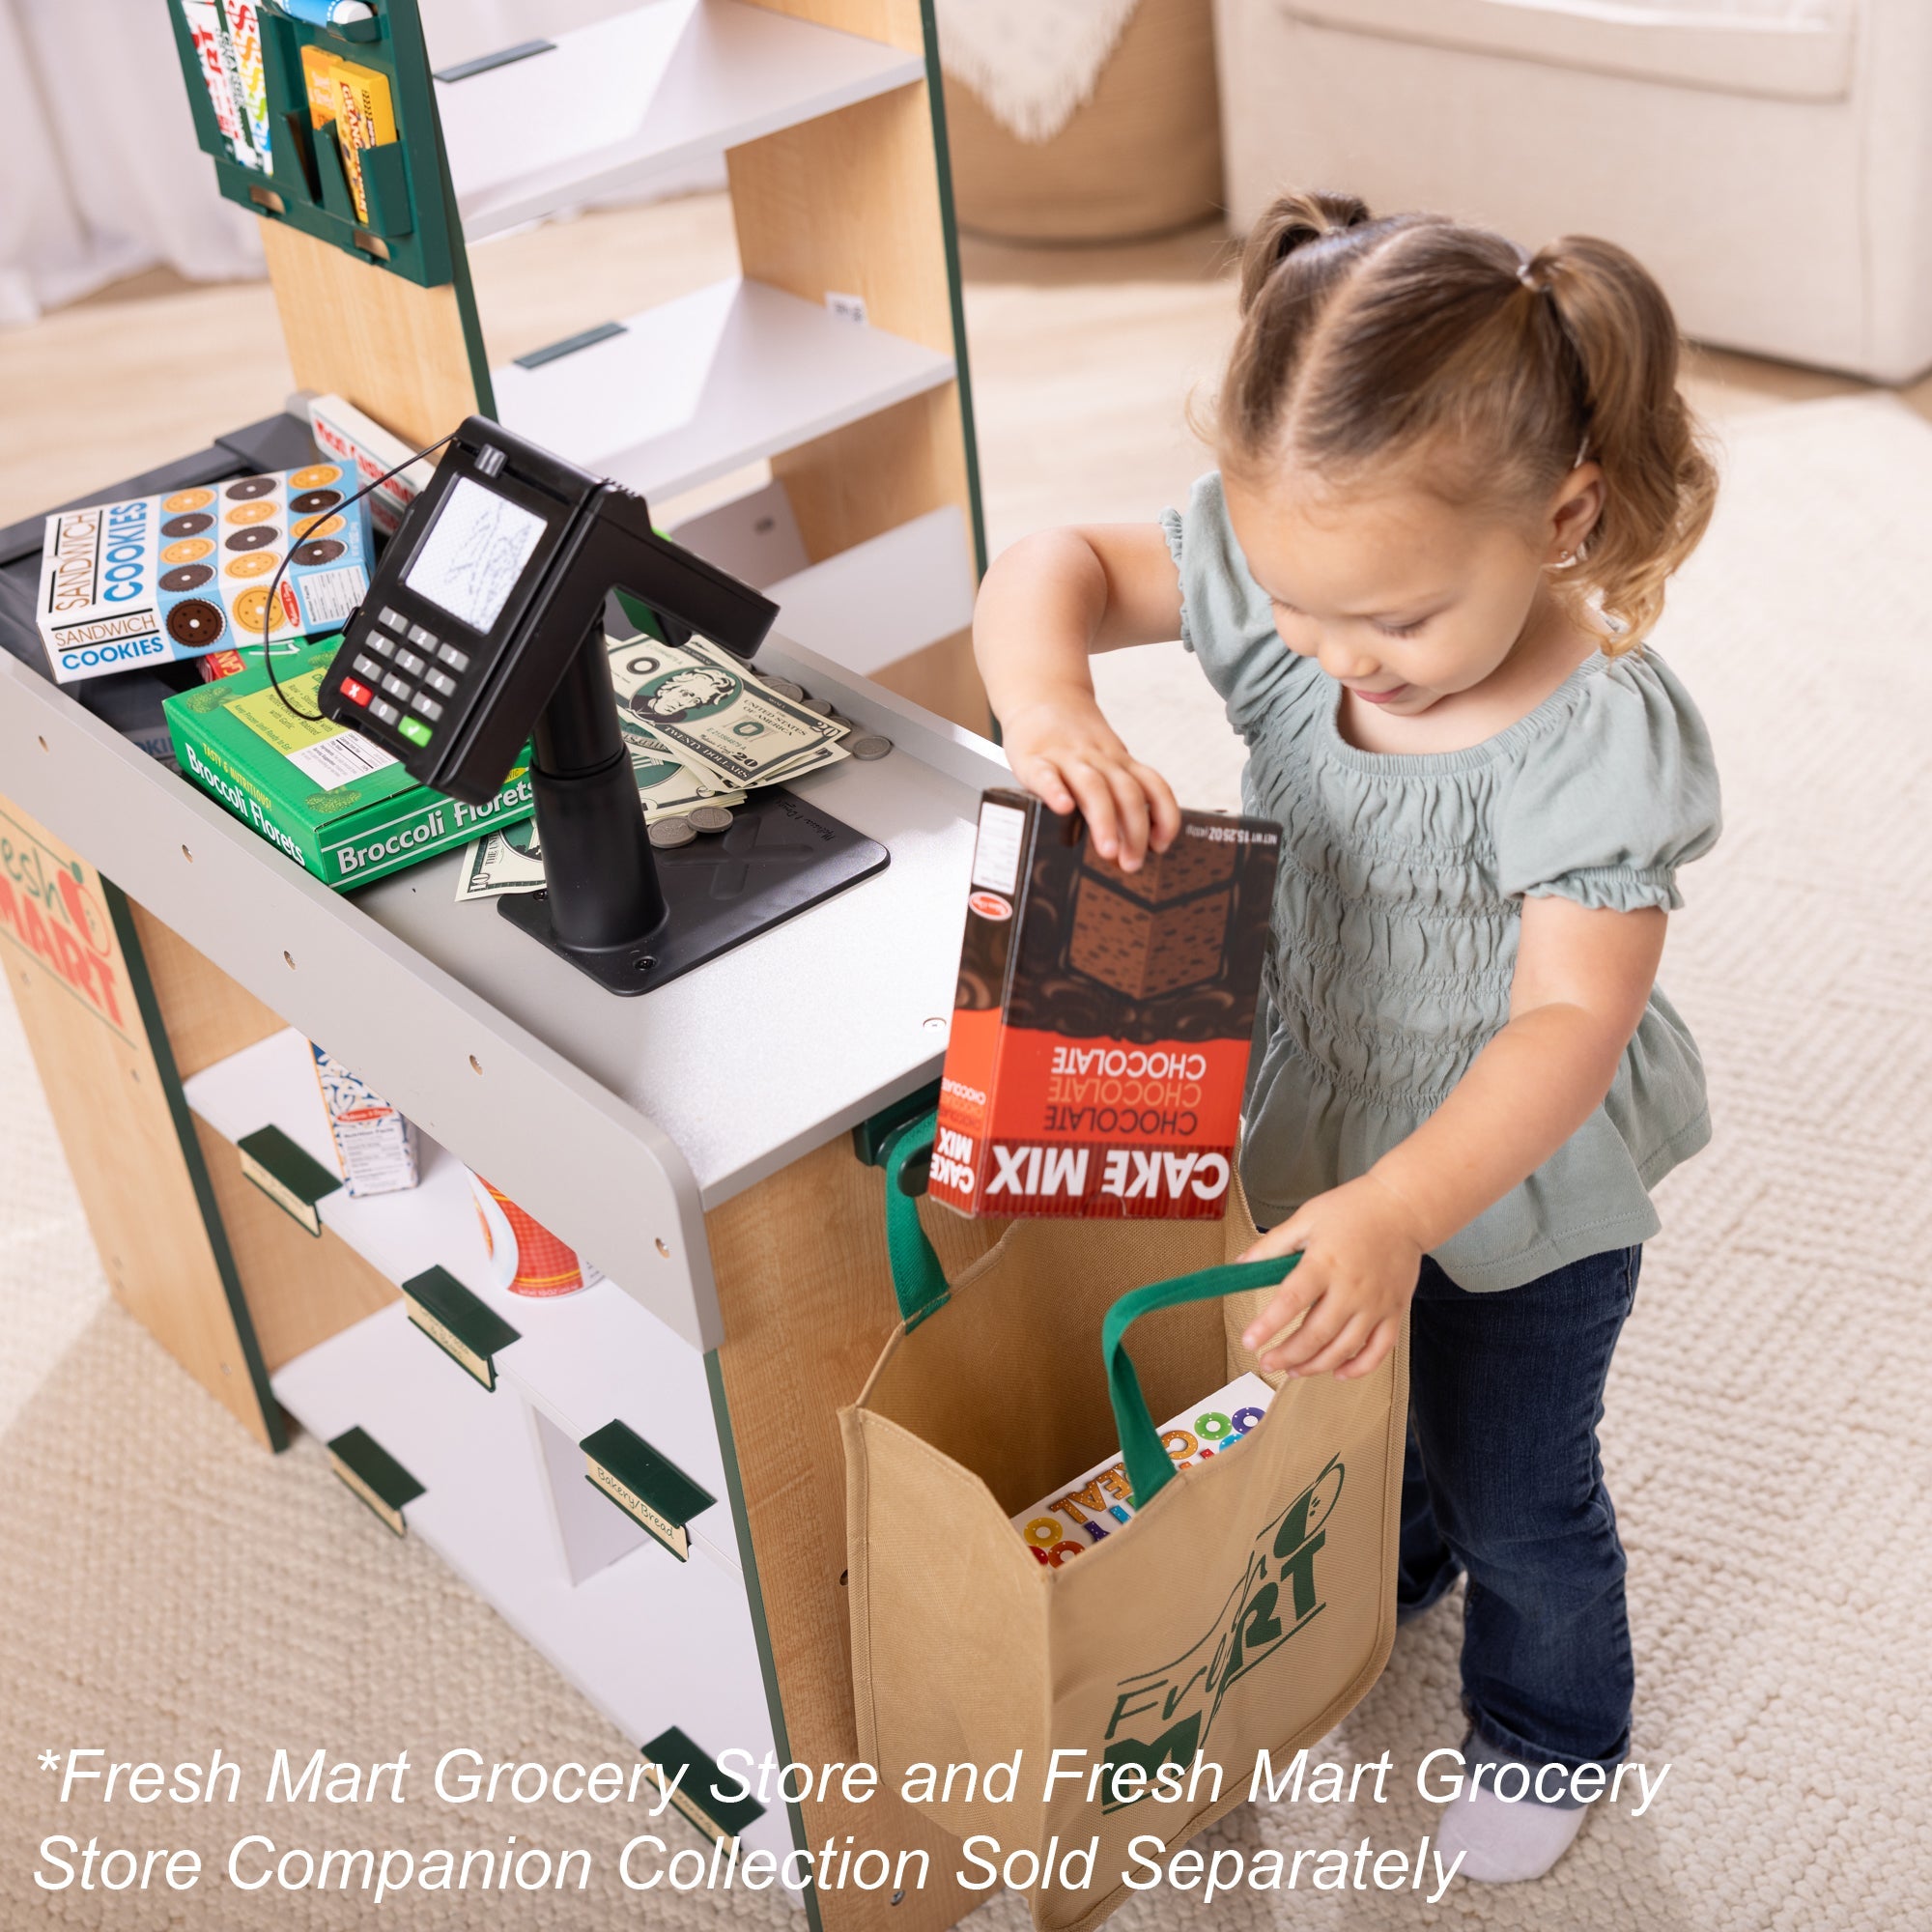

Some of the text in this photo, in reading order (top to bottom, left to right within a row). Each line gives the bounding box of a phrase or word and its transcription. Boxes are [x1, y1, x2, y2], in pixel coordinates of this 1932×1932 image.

[55, 510, 96, 611] SANDWICH
[103, 501, 147, 602] COOKIES
[55, 614, 156, 647] SANDWICH
[389, 614, 396, 625] 1
[375, 638, 384, 649] 4
[417, 632, 427, 641] 2
[62, 637, 164, 669] COOKIES
[361, 661, 372, 671] 7
[404, 656, 413, 668] 5
[447, 651, 458, 664] 3
[390, 679, 401, 692] 8
[435, 675, 444, 689] 6
[379, 704, 387, 717] 0
[422, 699, 432, 712] 9
[743, 699, 807, 736] UNITED STATES
[758, 714, 792, 736] AMERICA
[665, 725, 702, 751] TWENTY
[703, 747, 750, 778] DOLLARS
[731, 752, 758, 767] 20
[203, 743, 221, 767] TASTY
[230, 767, 271, 811] NUTRITIOUS!
[185, 742, 248, 818] Broccoli
[249, 798, 305, 867] Florets
[336, 810, 445, 874] Broccoli
[1051, 1046, 1207, 1081] CHOCOLATE
[1047, 1076, 1203, 1108] CHOCOLATE
[1044, 1105, 1199, 1136] CHOCOLATE
[937, 1126, 974, 1165] MIX
[929, 1152, 975, 1195] CAKE
[985, 1145, 1231, 1201] CAKE MIX
[1049, 1430, 1199, 1524] CEAL
